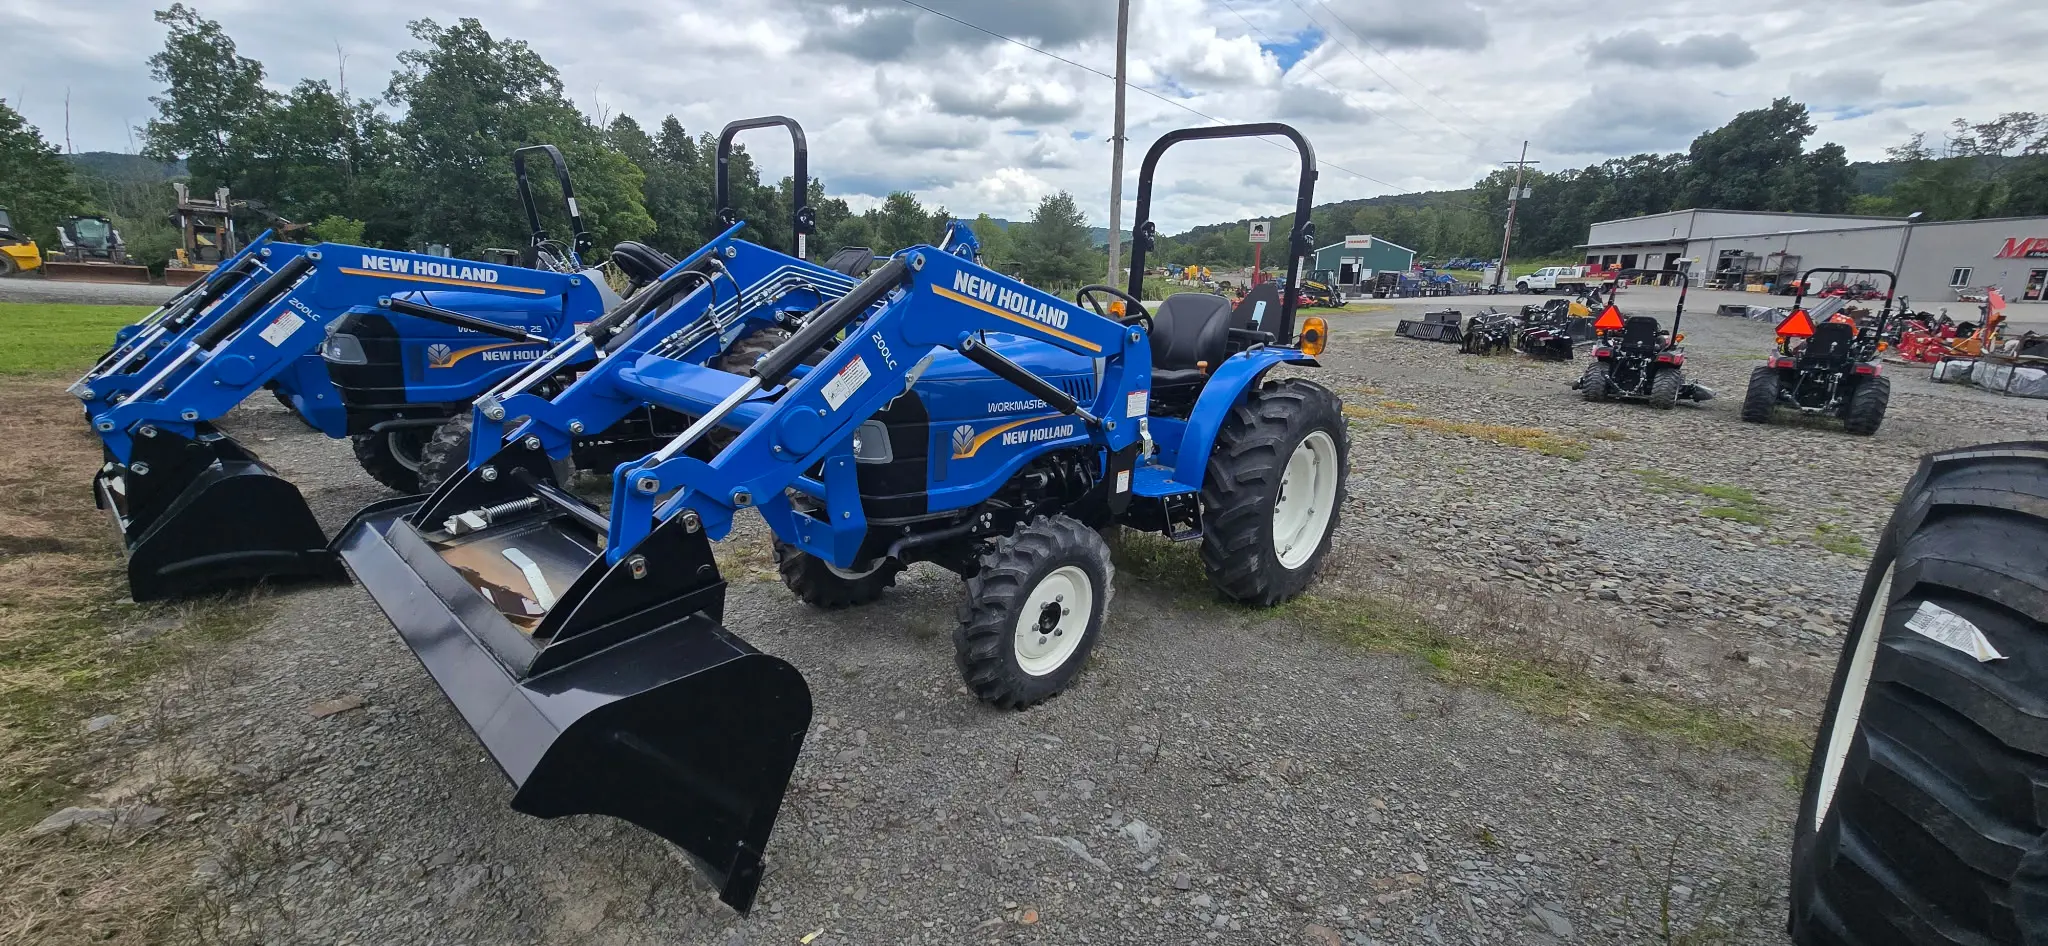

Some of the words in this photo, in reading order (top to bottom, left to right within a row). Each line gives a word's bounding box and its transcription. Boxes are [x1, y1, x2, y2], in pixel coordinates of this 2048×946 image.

[362, 254, 409, 273] NEW
[413, 260, 498, 283] HOLLAND
[288, 297, 320, 322] 200LC
[953, 269, 997, 303] NEW
[997, 286, 1069, 330] HOLLAND
[530, 325, 542, 333] 25
[482, 351, 510, 361] NEW
[871, 331, 897, 370] 200LC
[1002, 430, 1028, 446] NEW
[1029, 424, 1074, 443] HOLLAND
